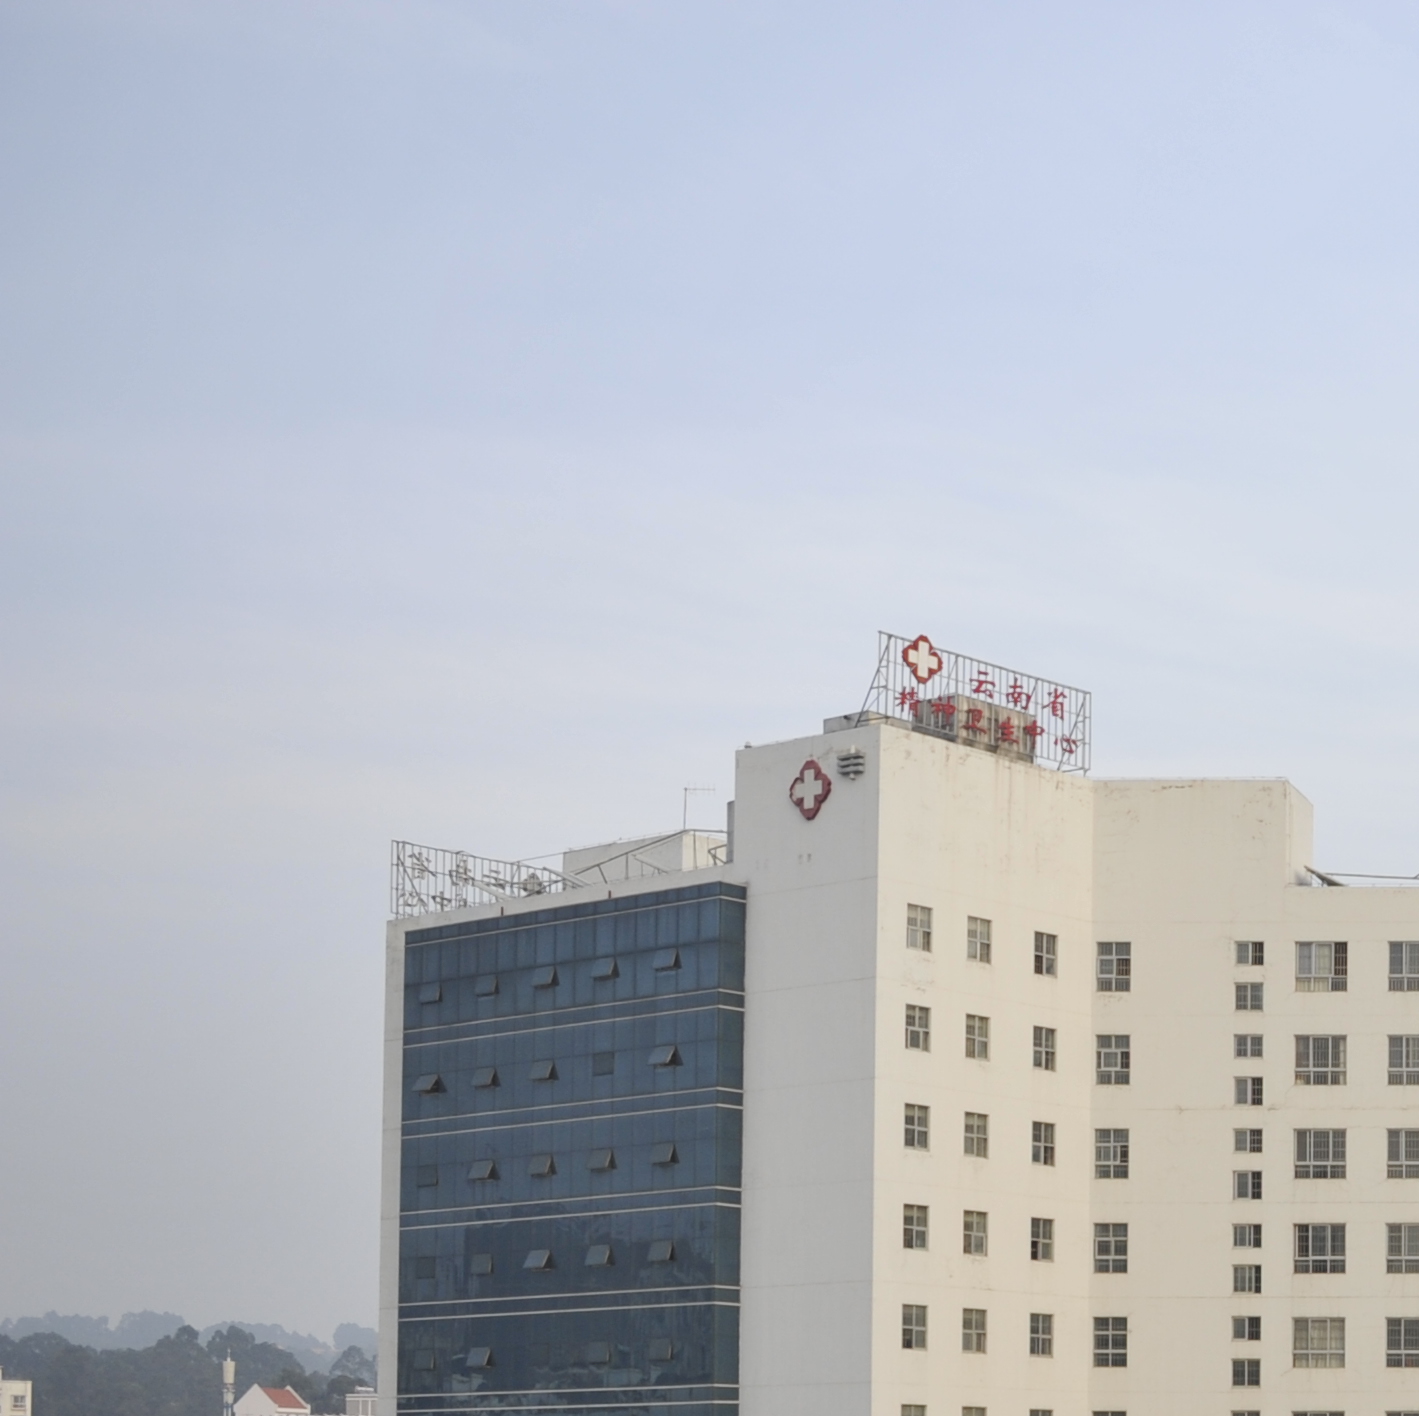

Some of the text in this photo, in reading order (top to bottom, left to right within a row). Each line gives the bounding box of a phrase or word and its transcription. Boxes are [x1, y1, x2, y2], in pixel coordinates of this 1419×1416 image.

[895, 686, 1078, 754] 精神卫生中心
[969, 670, 1068, 720] 云南省
